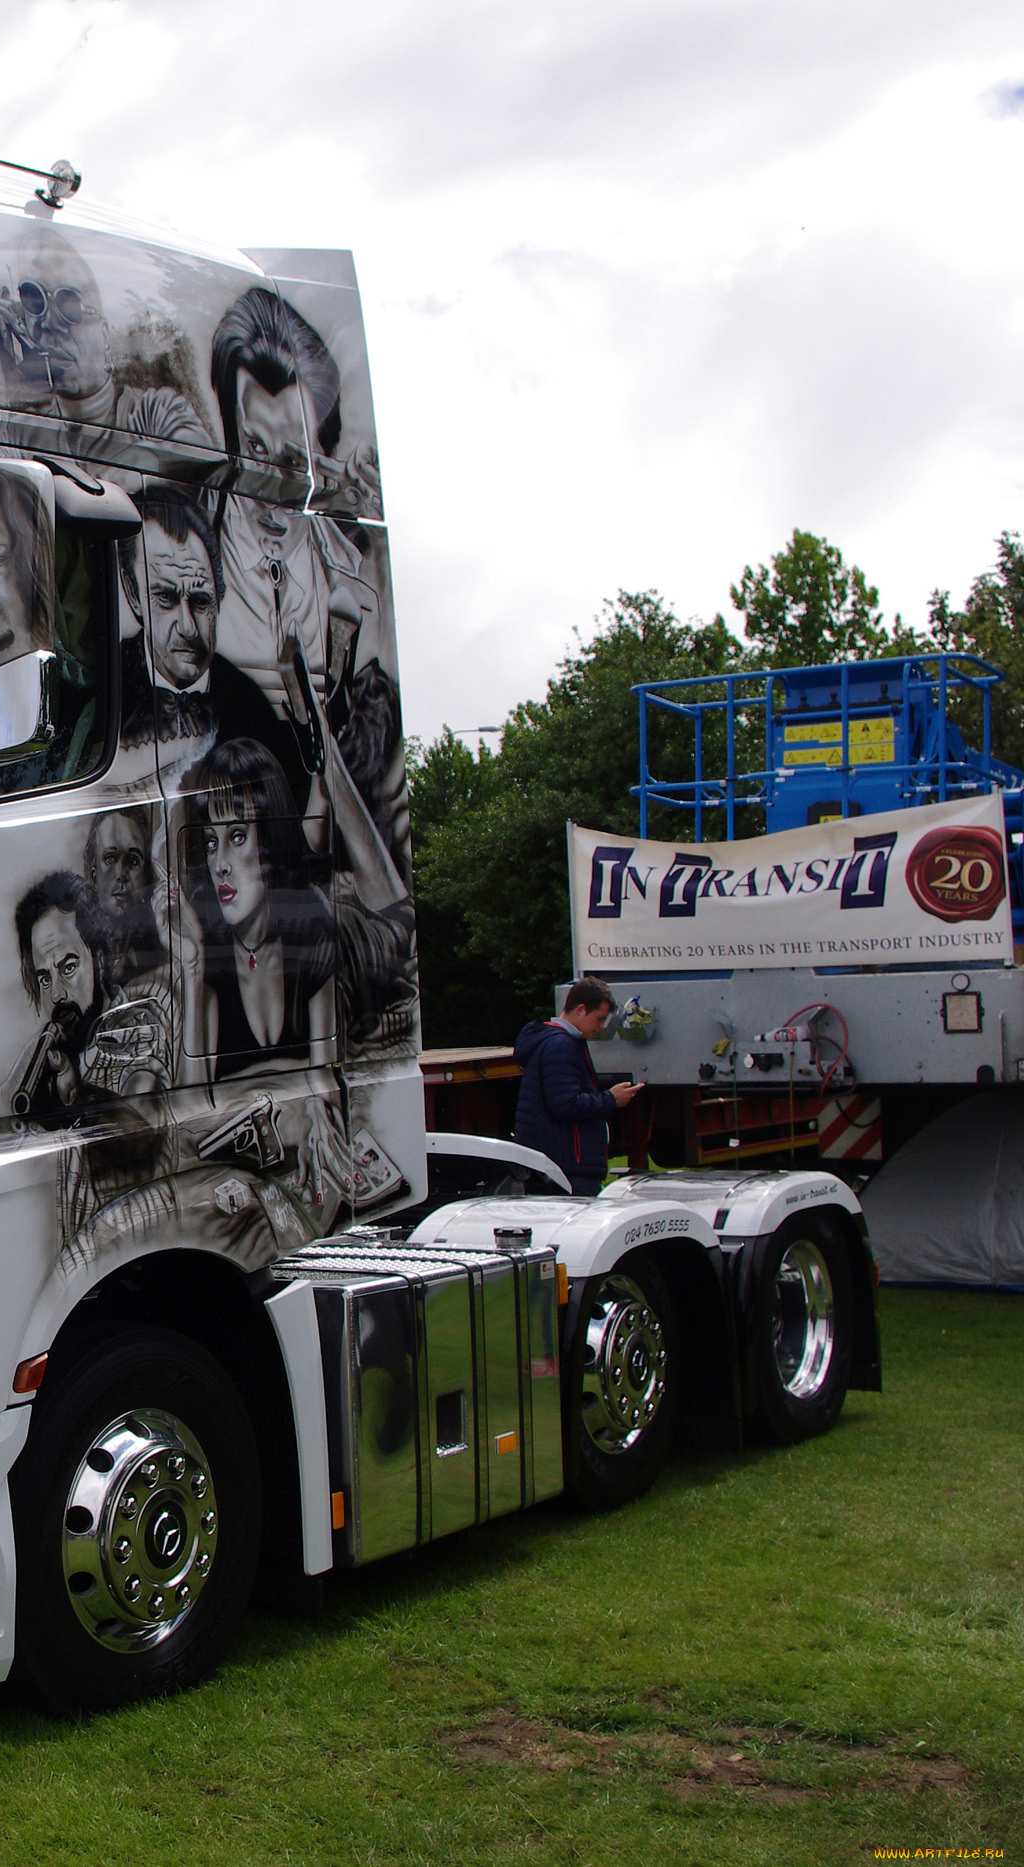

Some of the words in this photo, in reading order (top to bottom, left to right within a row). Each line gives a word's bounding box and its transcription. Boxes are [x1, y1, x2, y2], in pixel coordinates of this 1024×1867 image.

[660, 833, 897, 916] TRANSIT
[930, 855, 993, 893] 20
[935, 889, 979, 902] YEARS
[587, 943, 682, 958] CELEBRATING
[687, 946, 704, 957] 20
[708, 943, 755, 957] YEARS
[759, 943, 776, 956] IN
[780, 941, 813, 955] THE
[816, 936, 914, 954] TRANSPORT
[919, 931, 1004, 950] INDUSTRY
[643, 1219, 666, 1237] 7630
[668, 1219, 691, 1232] 5555
